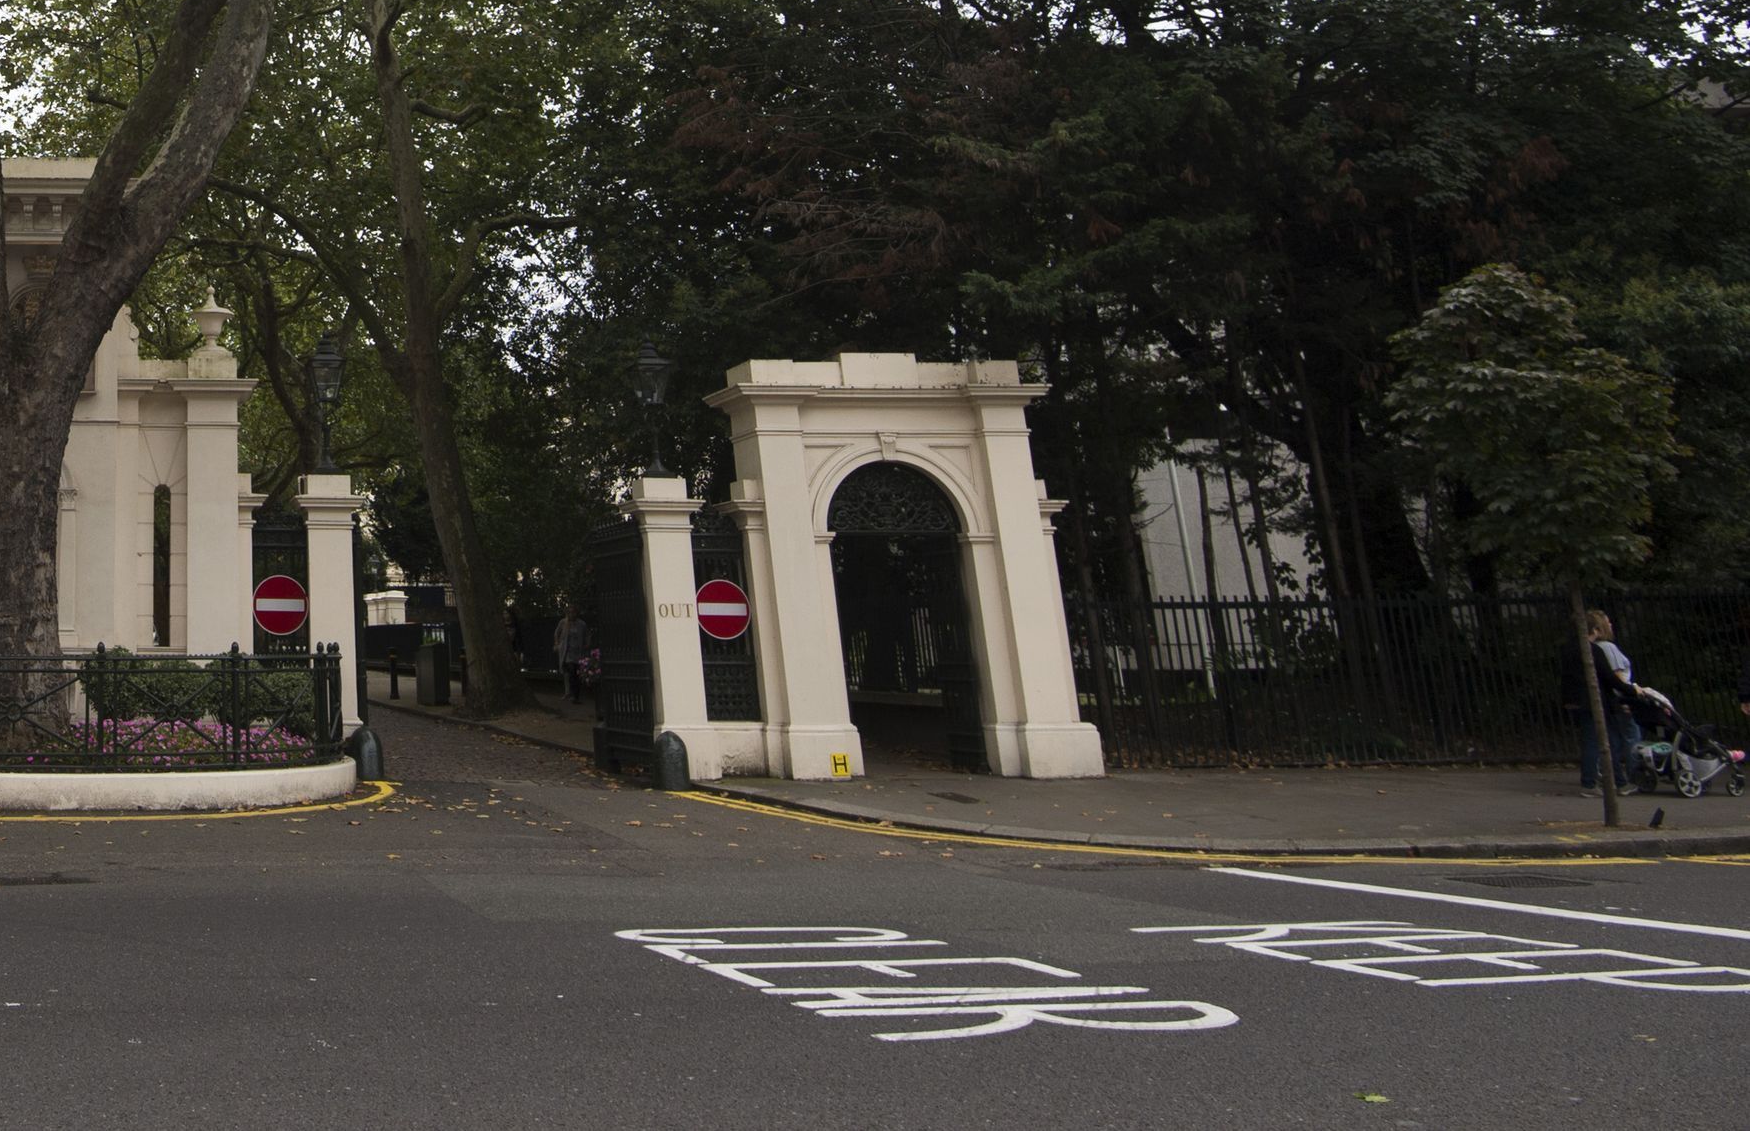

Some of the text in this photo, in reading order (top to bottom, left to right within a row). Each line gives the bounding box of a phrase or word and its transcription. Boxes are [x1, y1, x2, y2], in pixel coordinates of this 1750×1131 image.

[658, 603, 694, 618] OUT
[832, 754, 848, 773] H
[1130, 920, 1750, 992] KEEP
[614, 927, 1240, 1041] CLEAR
